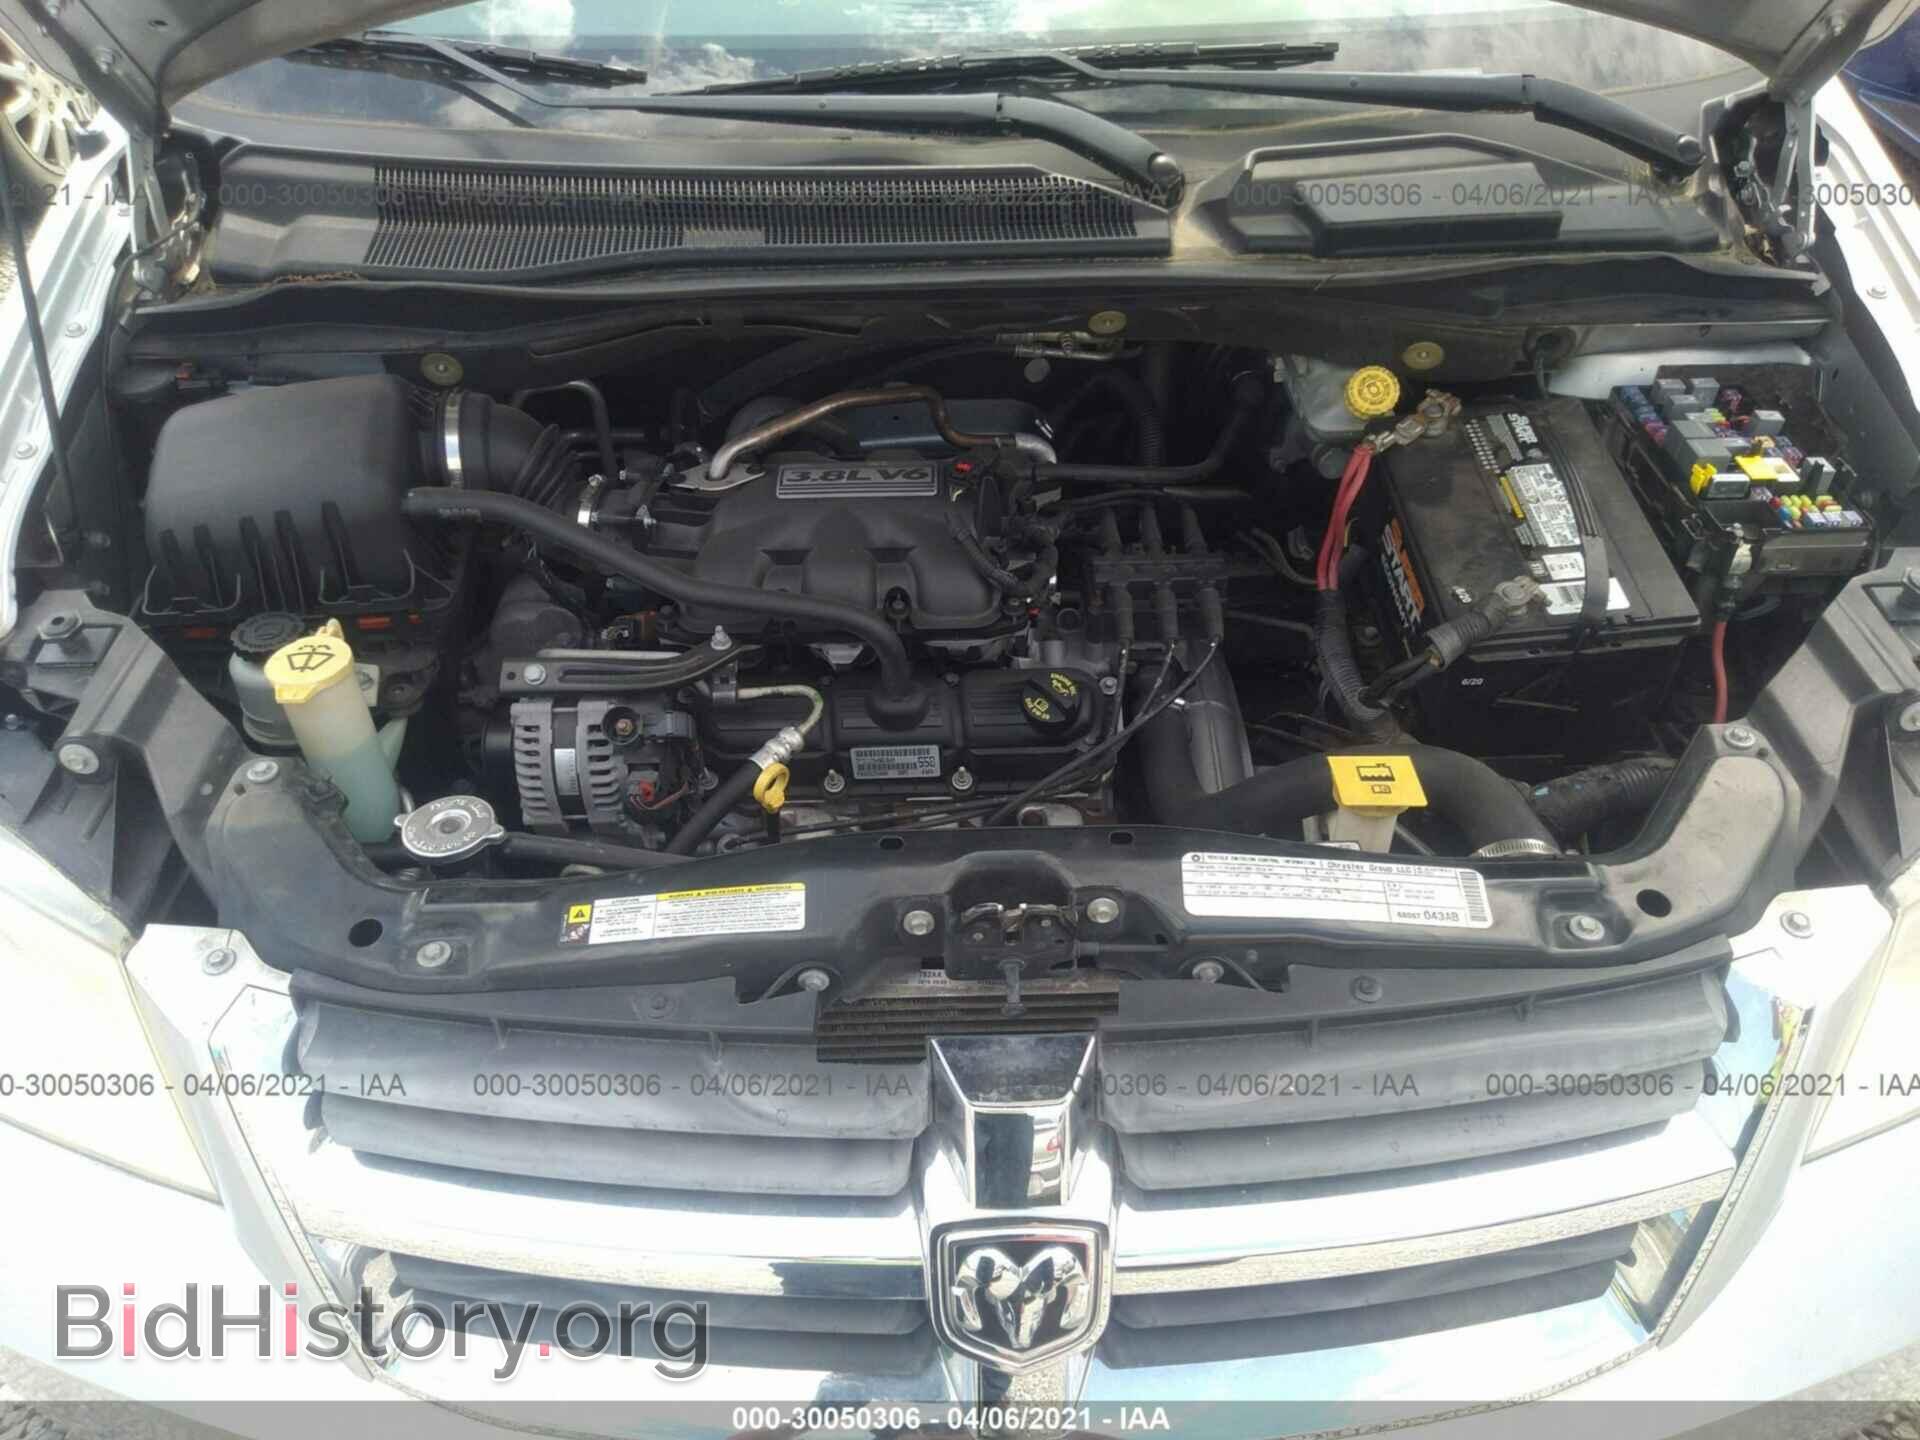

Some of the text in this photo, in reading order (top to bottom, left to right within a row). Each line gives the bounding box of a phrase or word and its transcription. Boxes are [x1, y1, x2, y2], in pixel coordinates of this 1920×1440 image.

[785, 468, 929, 483] 3.8L V6
[1327, 861, 1365, 871] Chrysler
[1369, 864, 1393, 873] Group
[1423, 910, 1460, 922] 043AB
